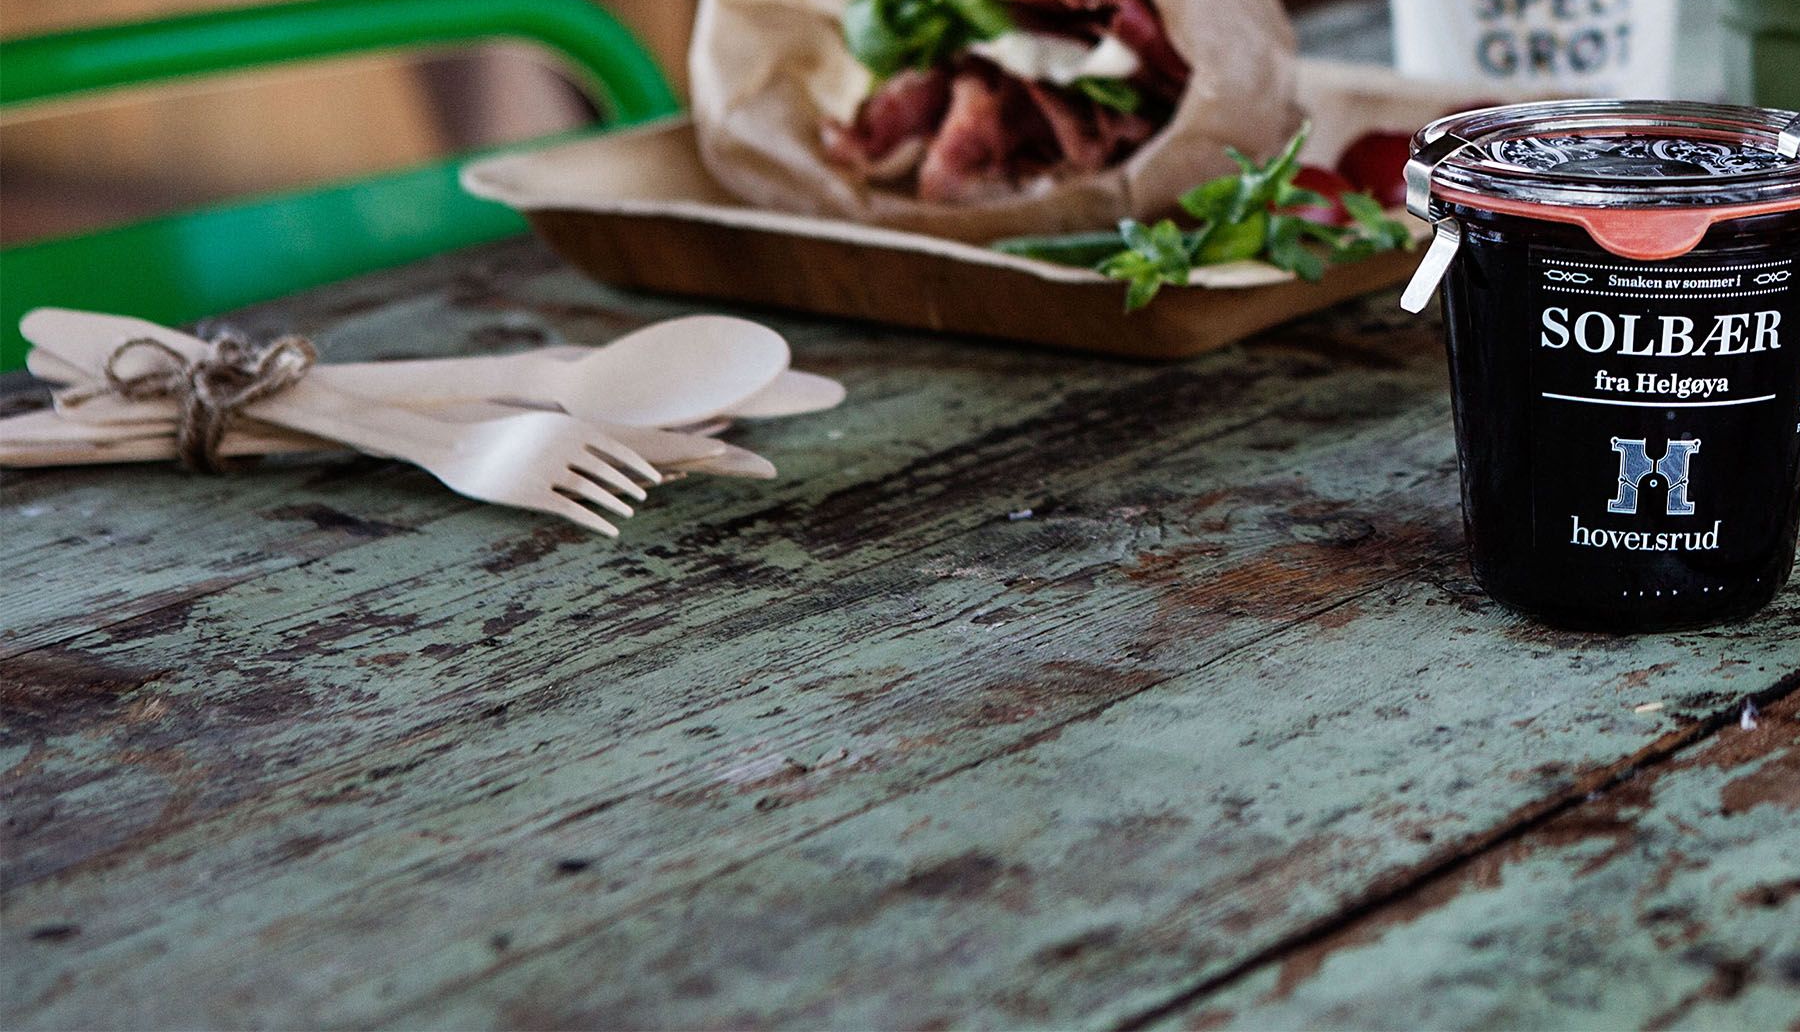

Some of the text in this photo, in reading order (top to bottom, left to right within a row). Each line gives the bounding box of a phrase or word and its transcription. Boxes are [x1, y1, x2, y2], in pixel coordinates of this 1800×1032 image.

[1608, 274, 1663, 289] Smaken
[1664, 279, 1682, 289] av
[1682, 277, 1735, 289] sommer
[1541, 306, 1782, 357] SOLBÆR
[1594, 369, 1729, 396] fra Helgøya
